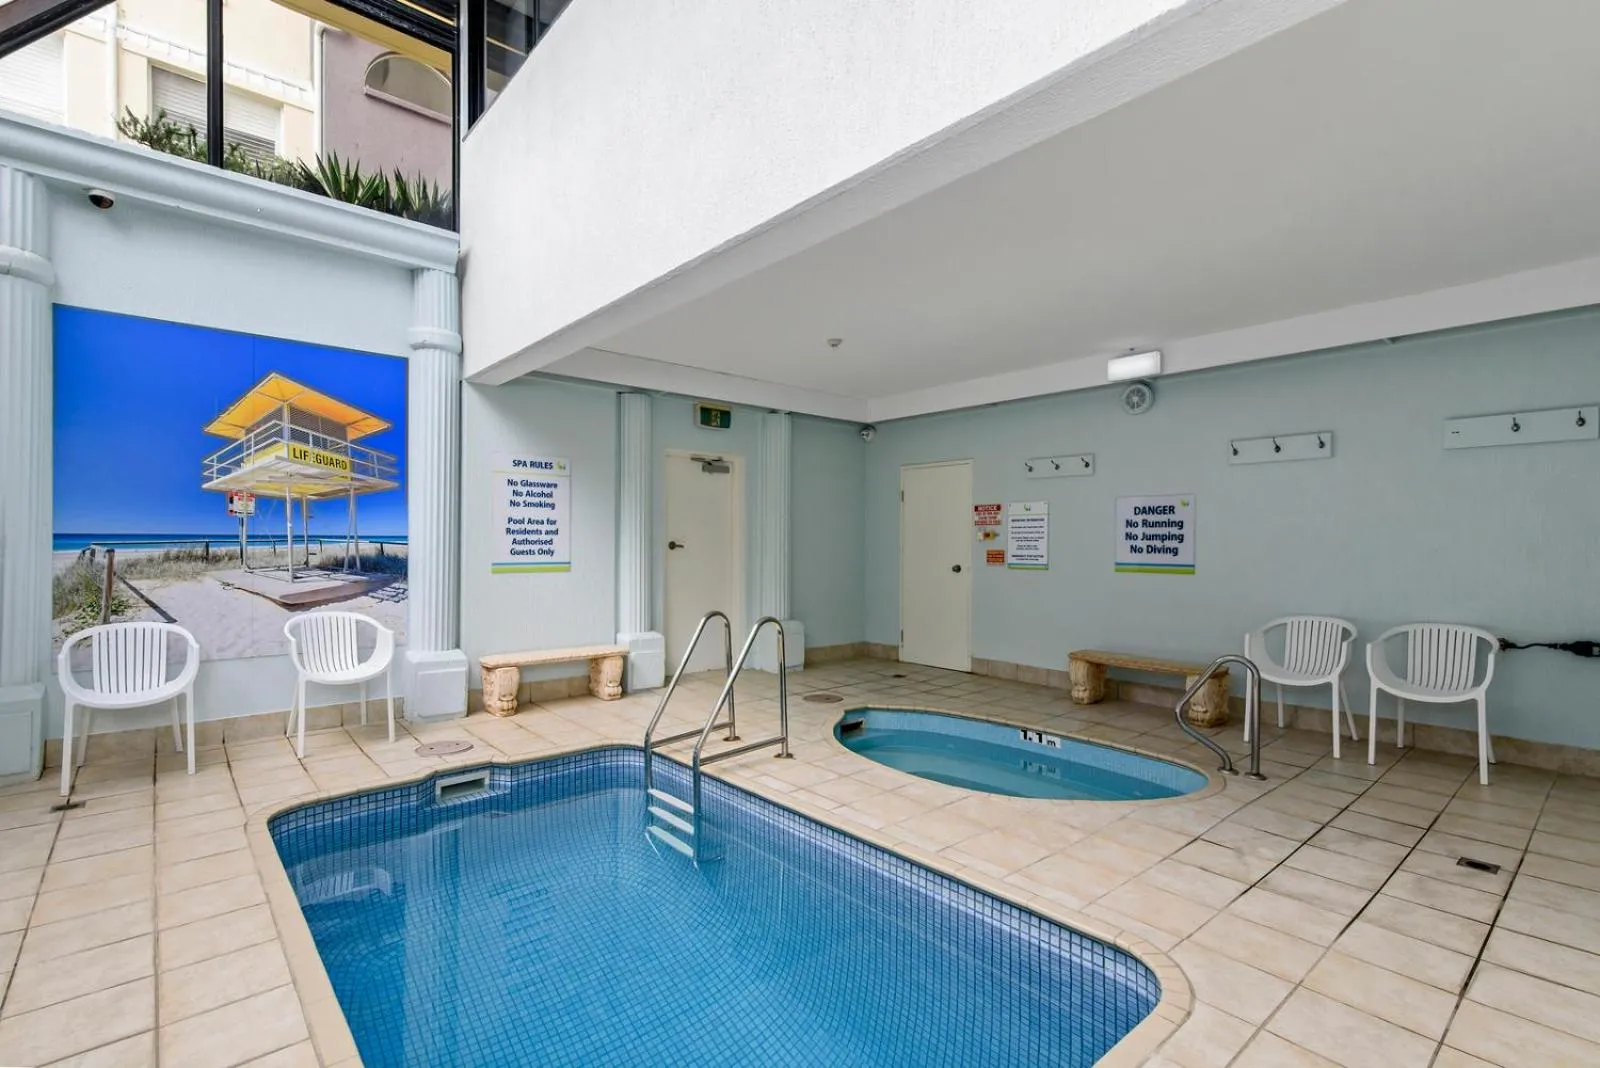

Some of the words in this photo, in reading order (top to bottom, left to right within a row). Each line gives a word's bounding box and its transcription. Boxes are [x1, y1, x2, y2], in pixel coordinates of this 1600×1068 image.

[293, 448, 347, 470] LIFGUARD
[512, 459, 527, 468] SPA
[530, 460, 553, 470] RULES
[507, 479, 518, 487] No
[520, 479, 558, 488] Glassware
[525, 490, 553, 498] Alcohol
[522, 500, 555, 510] Smoking
[1134, 505, 1175, 516] DANGER
[507, 517, 525, 525] Pool
[1125, 519, 1138, 528] No
[1141, 518, 1184, 530] Running
[506, 527, 542, 535] Residents
[544, 527, 558, 535] and
[511, 538, 553, 546] Authorised
[1125, 532, 1138, 541] No
[1141, 532, 1184, 543] Jumping
[510, 548, 536, 556] Guests
[537, 547, 555, 557] Only
[1130, 545, 1143, 554] No
[1146, 544, 1179, 557] Diving
